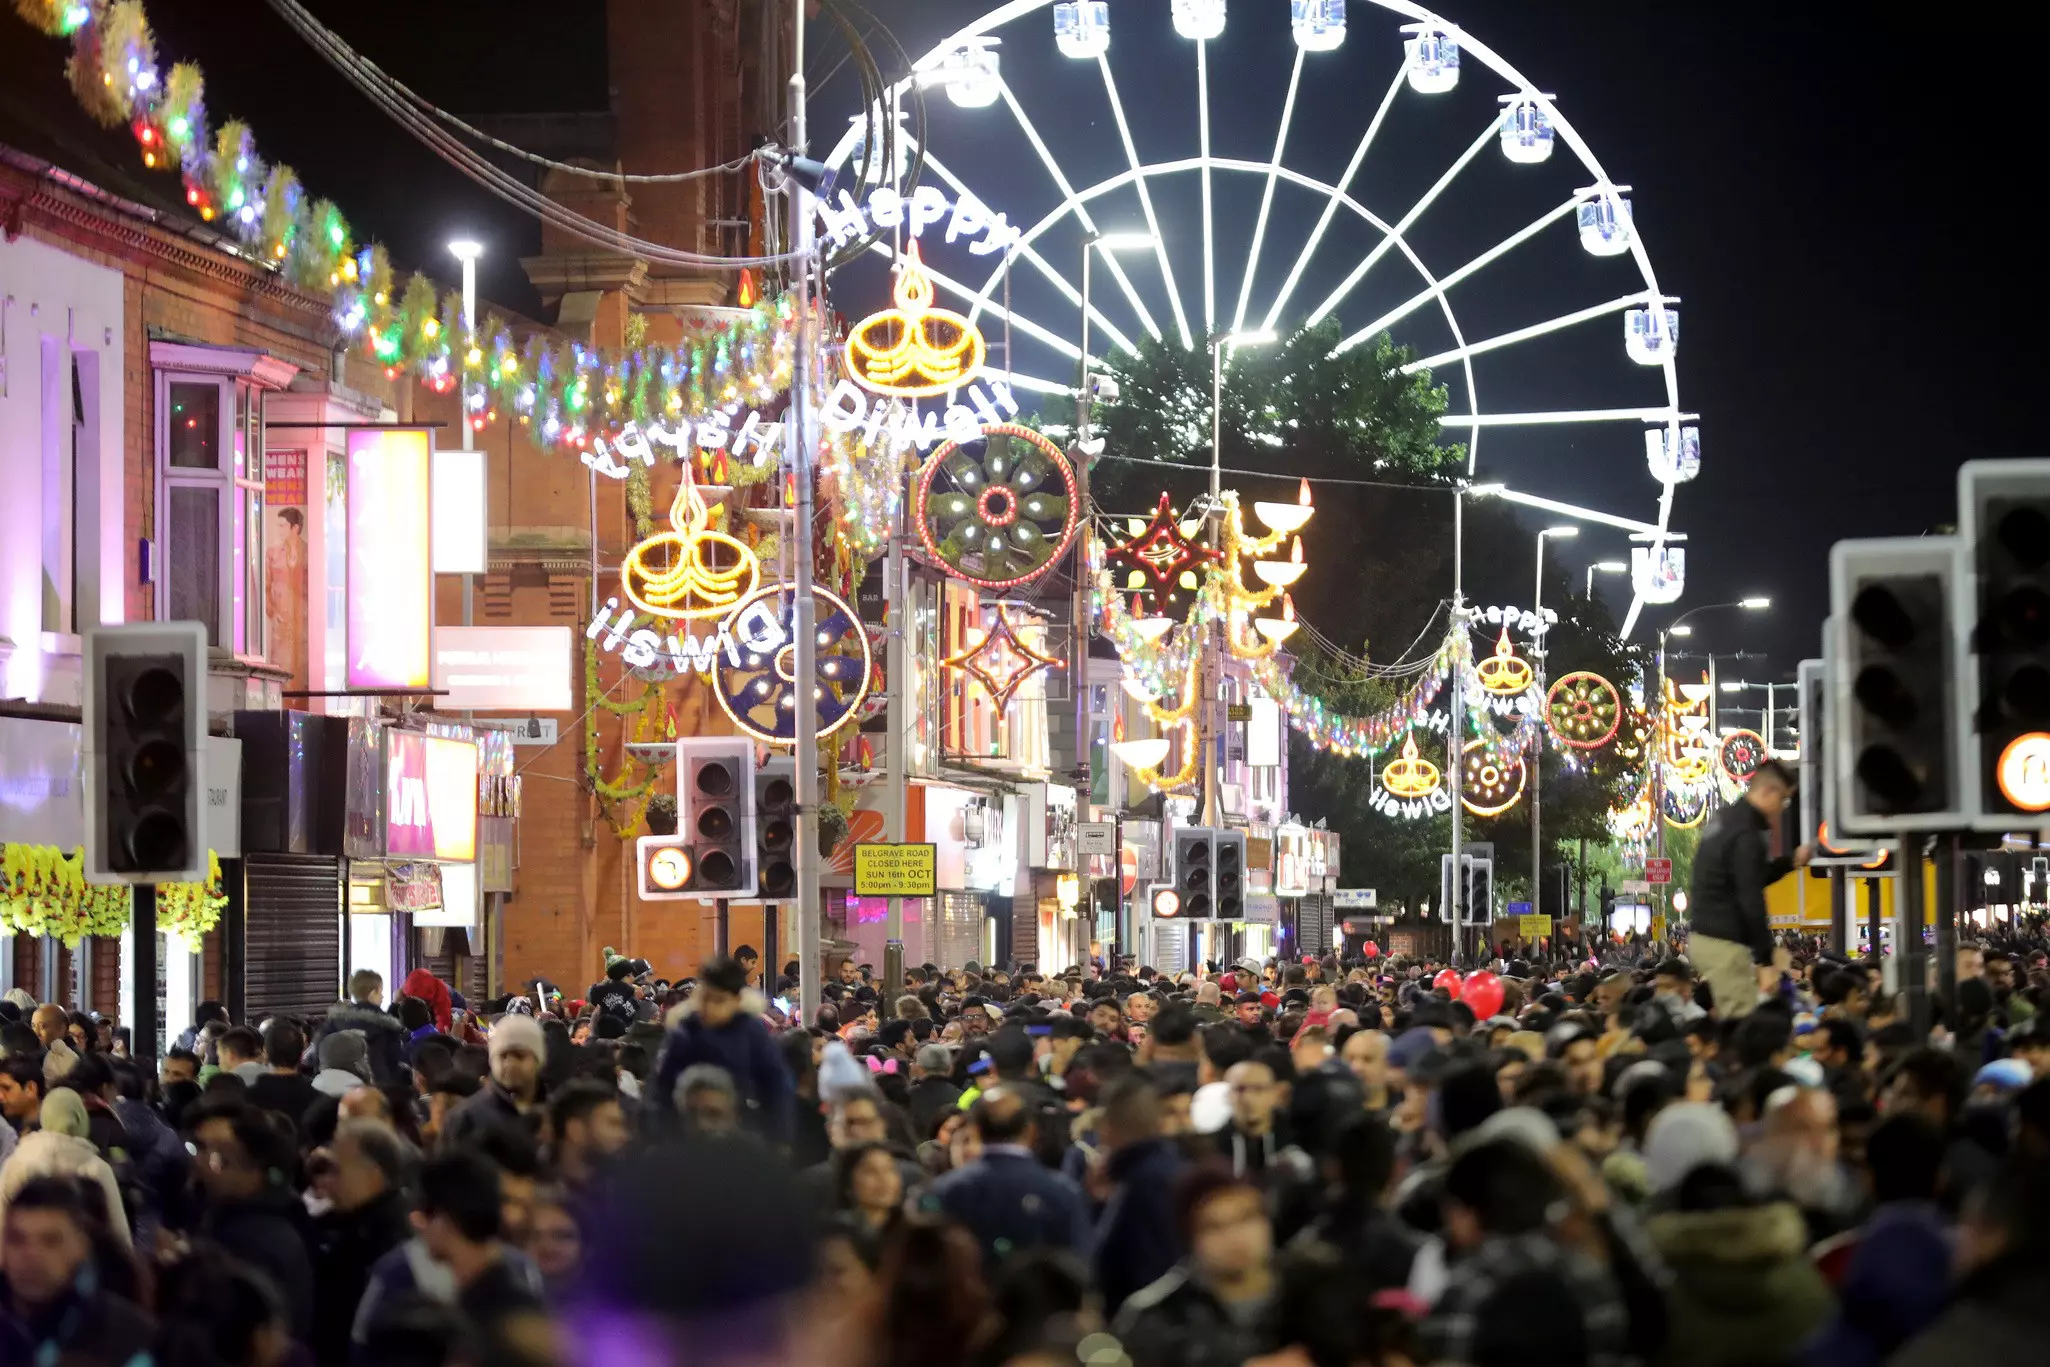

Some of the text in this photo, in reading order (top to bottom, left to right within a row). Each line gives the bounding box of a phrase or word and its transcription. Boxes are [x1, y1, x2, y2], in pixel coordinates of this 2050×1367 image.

[816, 185, 1021, 256] Happy
[818, 377, 1020, 450] Diwali
[861, 849, 930, 857] BELGRAVE ROAD
[867, 859, 924, 868] CLOSED HERE
[866, 869, 932, 879] SUN 16th OCT
[861, 881, 891, 890] 5:00pm
[898, 881, 930, 890] 9:30pm
